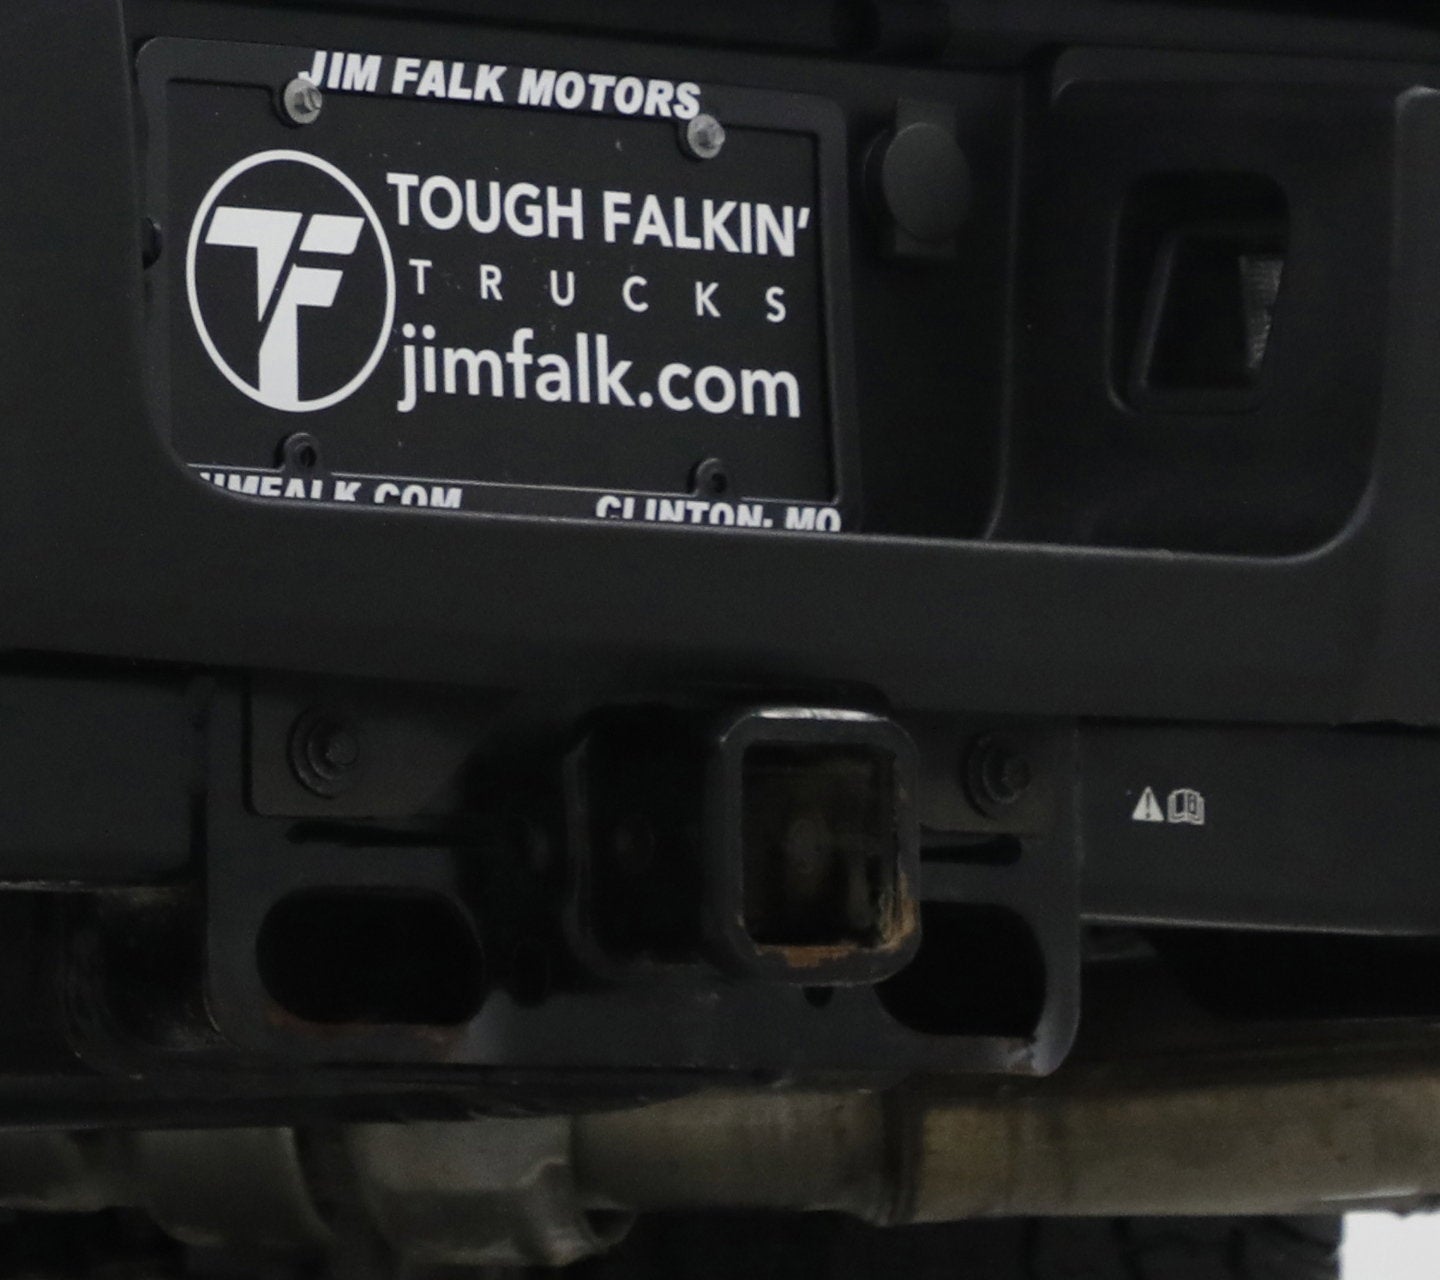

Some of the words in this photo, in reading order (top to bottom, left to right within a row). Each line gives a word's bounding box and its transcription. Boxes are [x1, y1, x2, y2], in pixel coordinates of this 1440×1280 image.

[298, 50, 382, 92] JIM
[390, 56, 508, 104] FALK
[517, 67, 702, 121] MOTORS
[386, 172, 585, 241] TOUGH
[603, 191, 811, 258] FALKIN'
[408, 258, 788, 323] TRUCKS
[397, 324, 801, 419] jimfalk.com
[784, 506, 842, 533] MO
